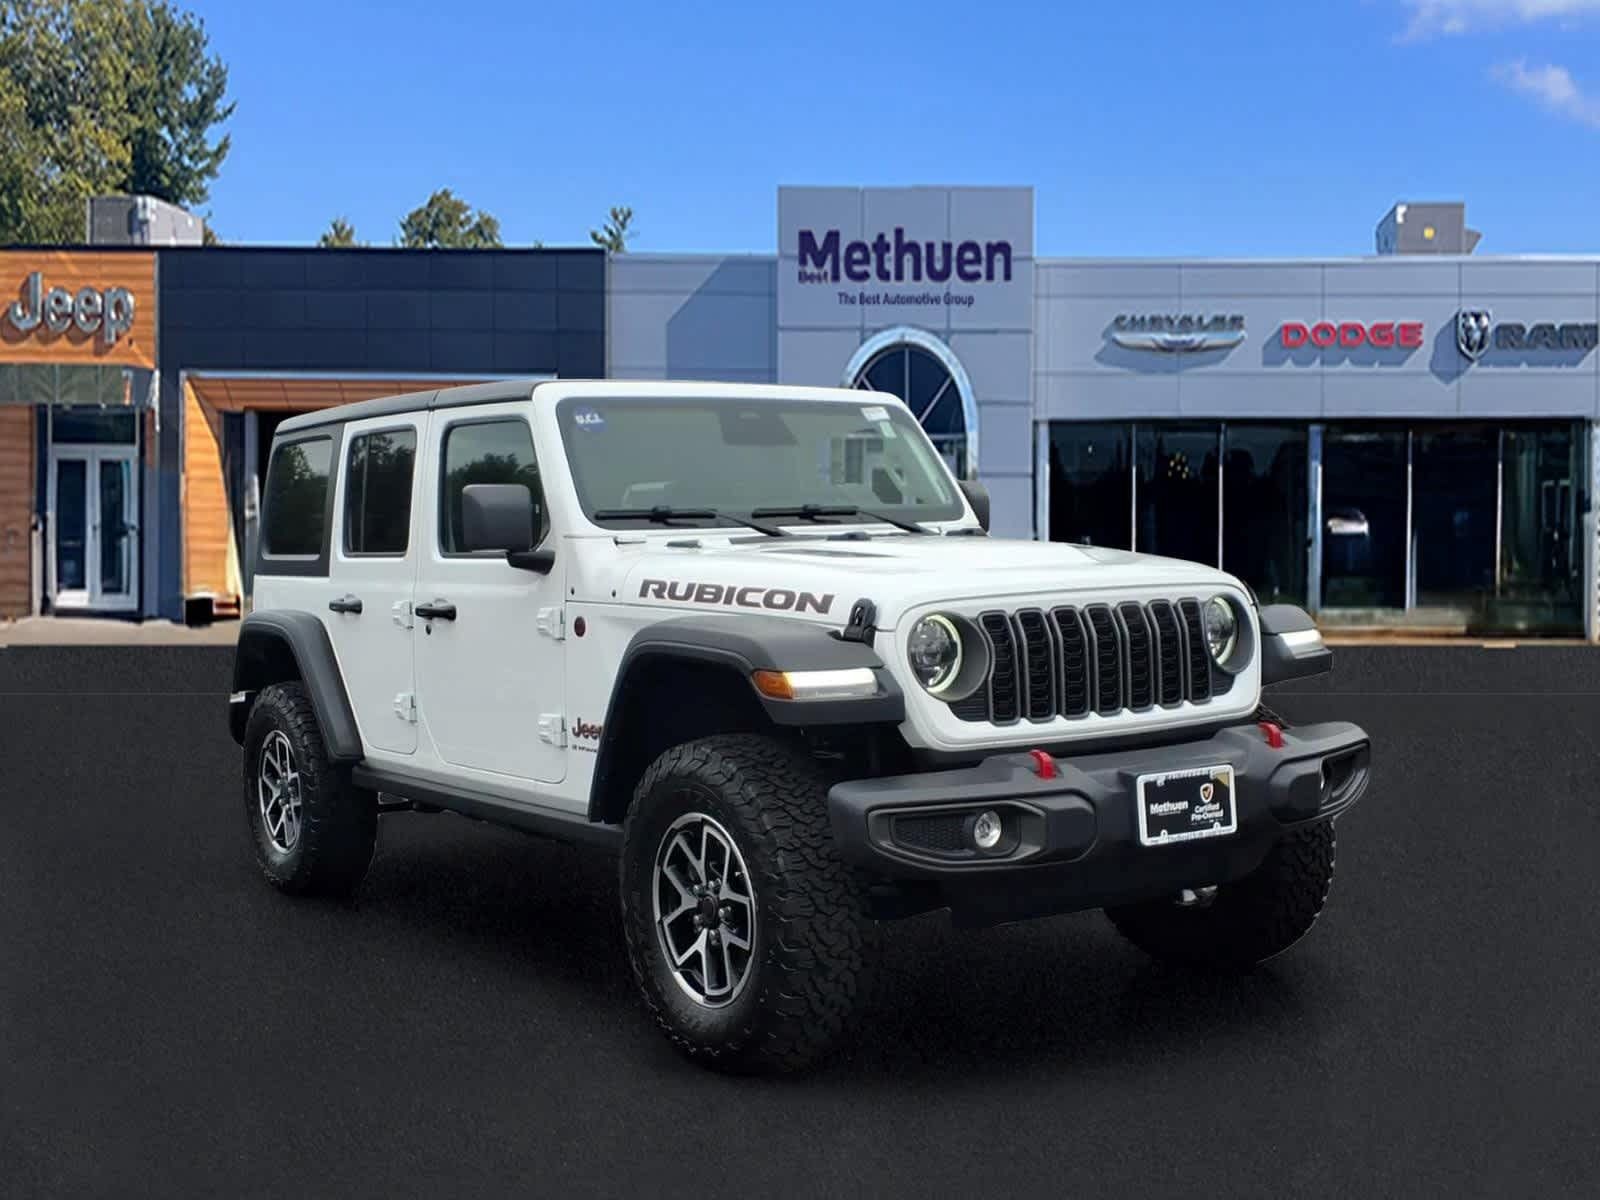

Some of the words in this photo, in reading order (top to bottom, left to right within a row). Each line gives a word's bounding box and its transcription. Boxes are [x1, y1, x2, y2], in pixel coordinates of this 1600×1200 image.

[798, 227, 1012, 282] Methuen
[9, 272, 134, 343] Jeep
[838, 292, 856, 305] The
[859, 292, 881, 305] Best
[883, 292, 940, 305] Automotive
[943, 292, 974, 307] Group
[1114, 314, 1245, 331] CHRYSLER
[1281, 322, 1423, 348] DODGE
[1495, 323, 1599, 350] RAM
[639, 579, 835, 614] RUBICON
[1149, 801, 1188, 815] Methuen
